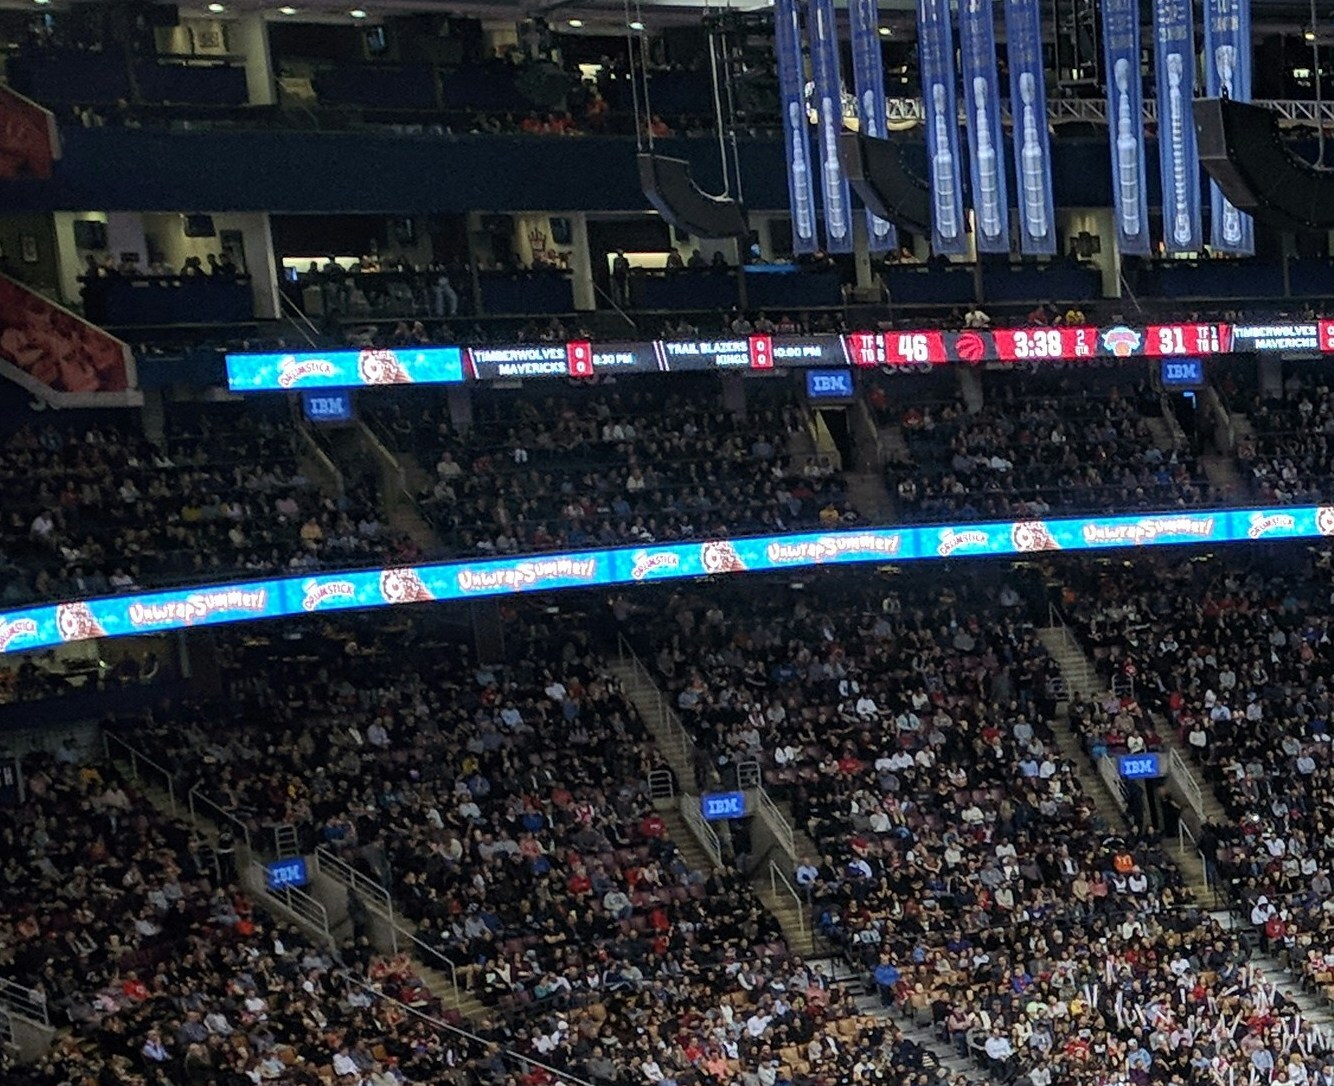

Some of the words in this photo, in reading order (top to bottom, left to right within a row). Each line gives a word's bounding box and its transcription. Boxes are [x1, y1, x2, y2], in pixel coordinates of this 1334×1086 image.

[1013, 330, 1062, 357] 3:38
[1076, 331, 1085, 345] 2
[1159, 328, 1186, 354] 31
[898, 335, 928, 362] 46
[1167, 364, 1196, 379] IBM
[813, 375, 844, 392] IBM
[311, 398, 343, 414] IBM
[1125, 760, 1152, 775] IBM
[709, 798, 738, 814] IBM
[273, 865, 300, 882] IBM
